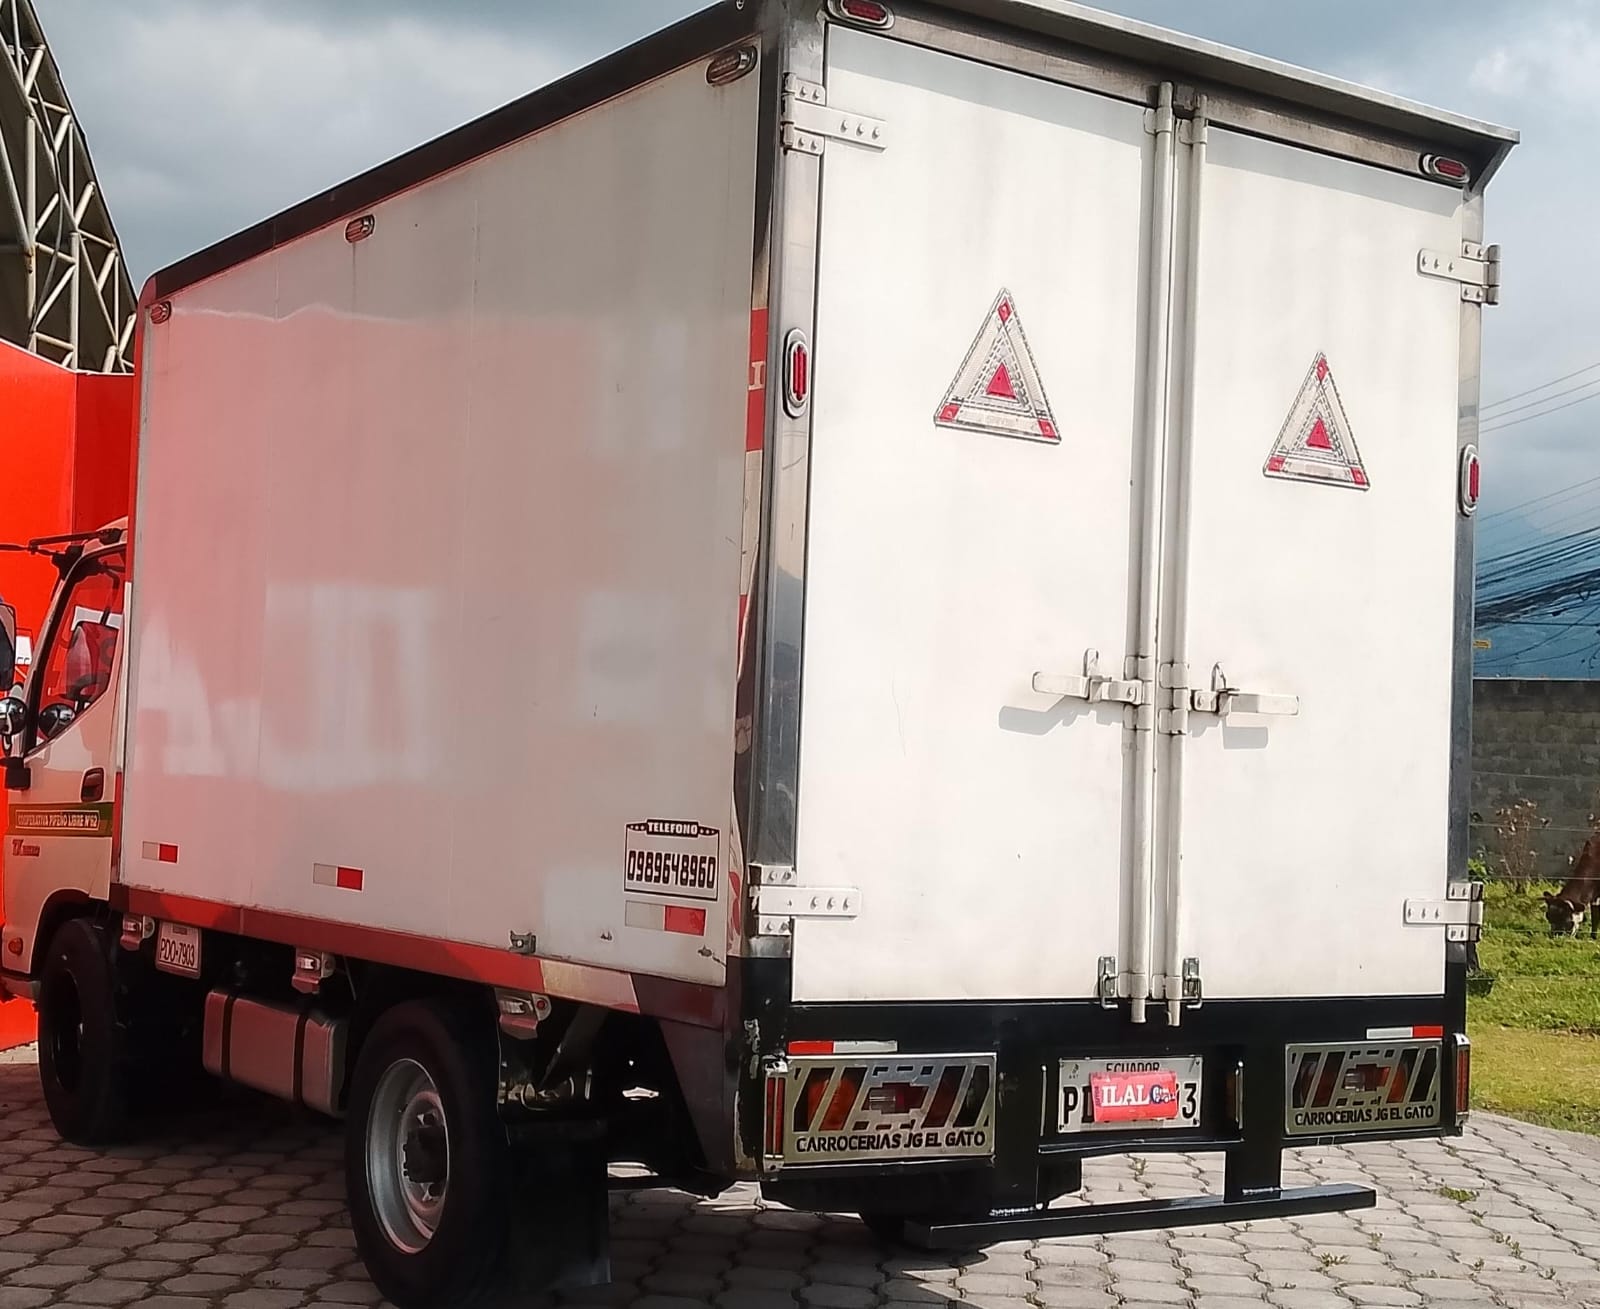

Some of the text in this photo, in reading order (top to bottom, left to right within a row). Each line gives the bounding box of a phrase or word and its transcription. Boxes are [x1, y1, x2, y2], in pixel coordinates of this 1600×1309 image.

[647, 822, 699, 835] TELEFONO
[627, 850, 717, 889] 0989648960
[1295, 1109, 1372, 1126] CARROCERIAS
[1390, 1107, 1402, 1120] EL
[1404, 1105, 1434, 1120] GATO
[796, 1131, 986, 1152] CARROCERIAS JG EL GATO
